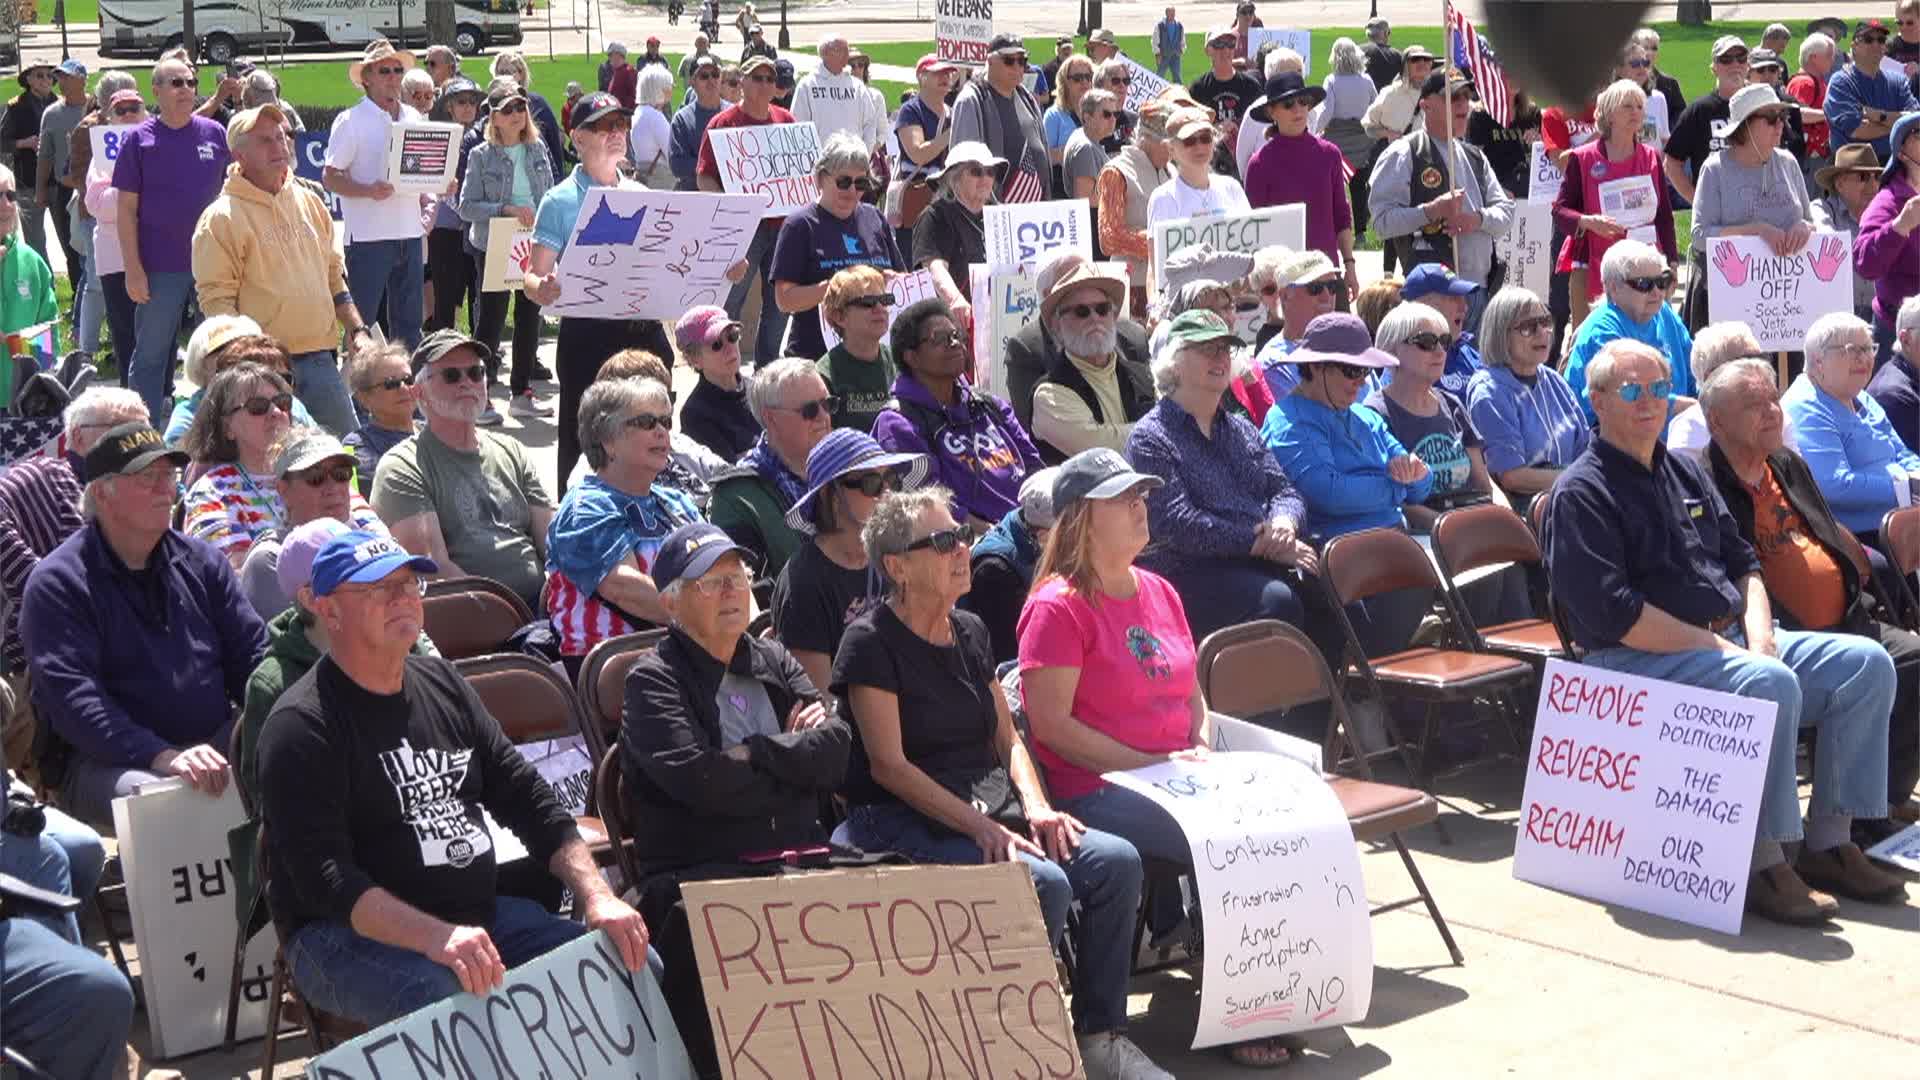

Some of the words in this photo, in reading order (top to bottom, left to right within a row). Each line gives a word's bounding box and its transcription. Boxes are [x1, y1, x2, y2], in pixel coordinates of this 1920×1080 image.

[937, 0, 993, 20] VETERANS
[1127, 63, 1163, 96] HAND
[725, 130, 760, 159] NO
[725, 157, 758, 184] NO
[1538, 169, 1561, 182] CAU
[767, 175, 823, 207] TRUM
[1165, 217, 1272, 257] PROTECT
[1751, 256, 1805, 281] HANDS
[1760, 278, 1800, 300] OFF!
[1545, 672, 1649, 728] REMOVE
[1672, 702, 1756, 733] CORRUPT
[1657, 721, 1762, 760] POLITICIANS
[1535, 734, 1642, 792] REVERSE
[400, 769, 466, 810] BEER
[1683, 766, 1722, 795] THE
[1654, 786, 1743, 825] DAMAGE
[414, 816, 481, 842] HERE
[1524, 801, 1626, 859] RECLAIM
[1660, 835, 1705, 868] OUR
[1622, 855, 1737, 905] DEMOCRACY
[702, 899, 1022, 992] RESTORE
[1240, 918, 1288, 952] Anger
[1223, 937, 1322, 978] Corruption
[1225, 971, 1302, 1015] Surprised?
[1305, 976, 1345, 1014] NO
[716, 980, 1076, 1080] KINDNESS
